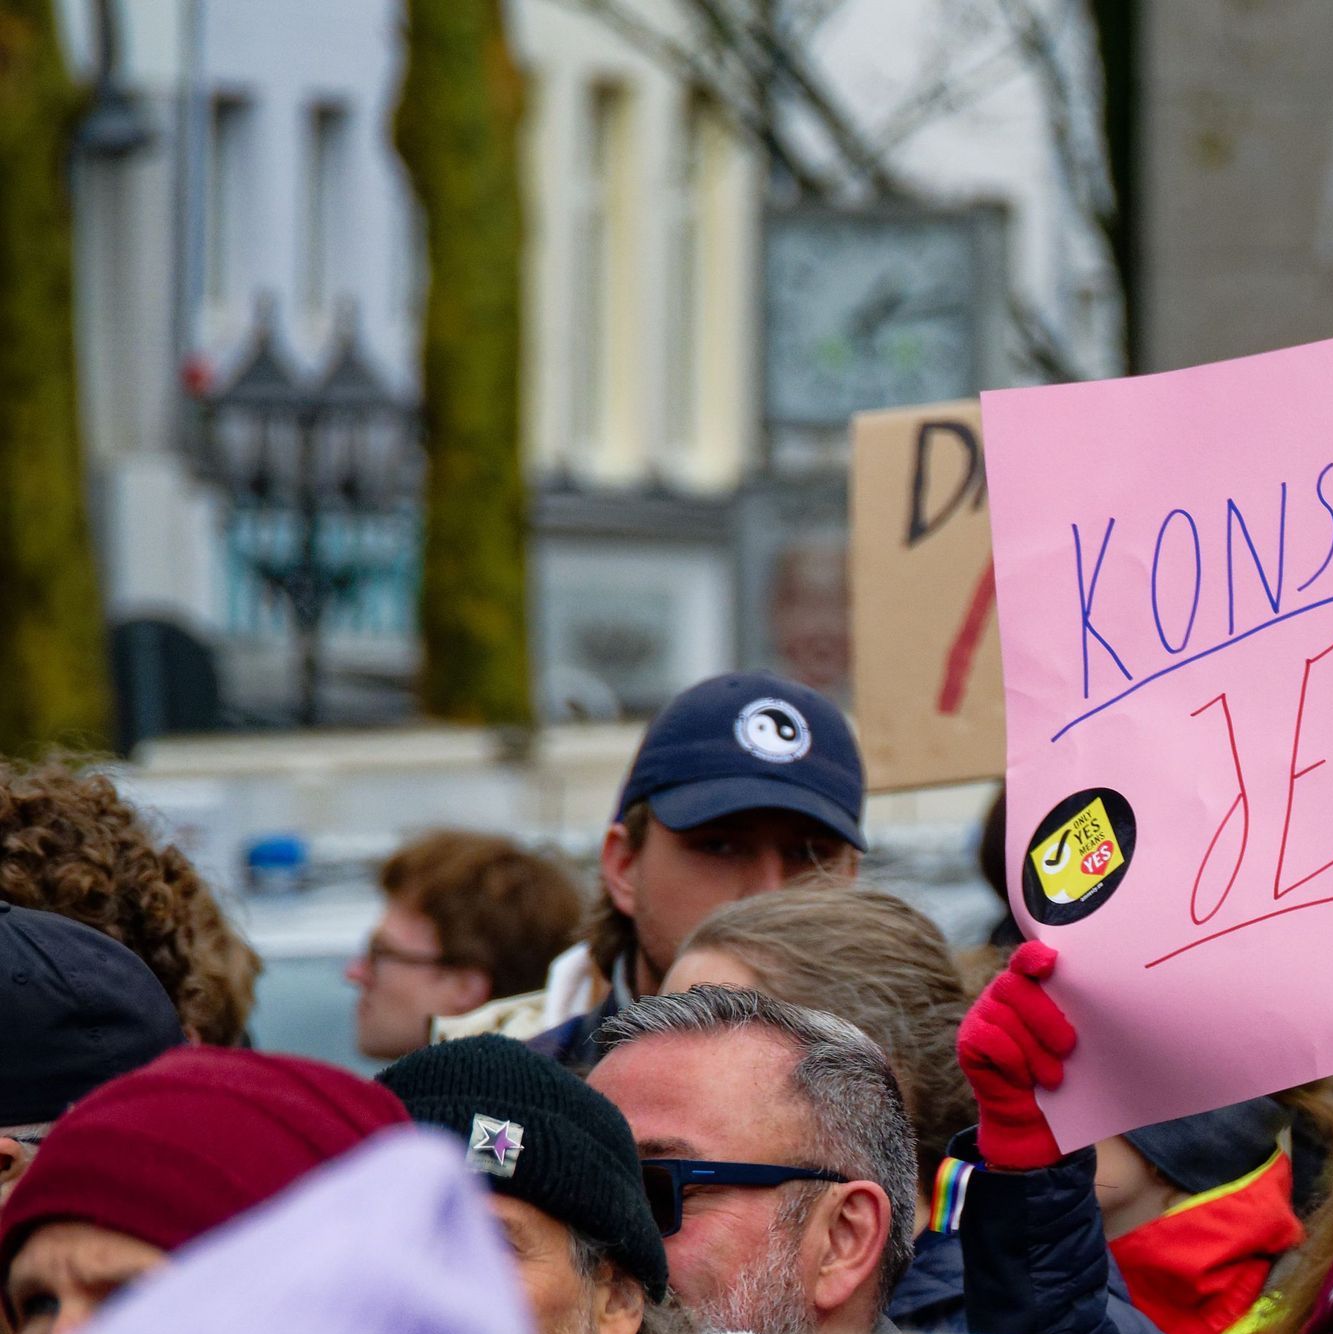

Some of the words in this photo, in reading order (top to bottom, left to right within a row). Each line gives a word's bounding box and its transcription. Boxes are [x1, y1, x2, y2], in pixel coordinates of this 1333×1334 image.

[1073, 809, 1093, 830] ONLY
[1073, 818, 1101, 845] YES
[1079, 831, 1106, 857] MEANS
[1083, 845, 1113, 873] YES
